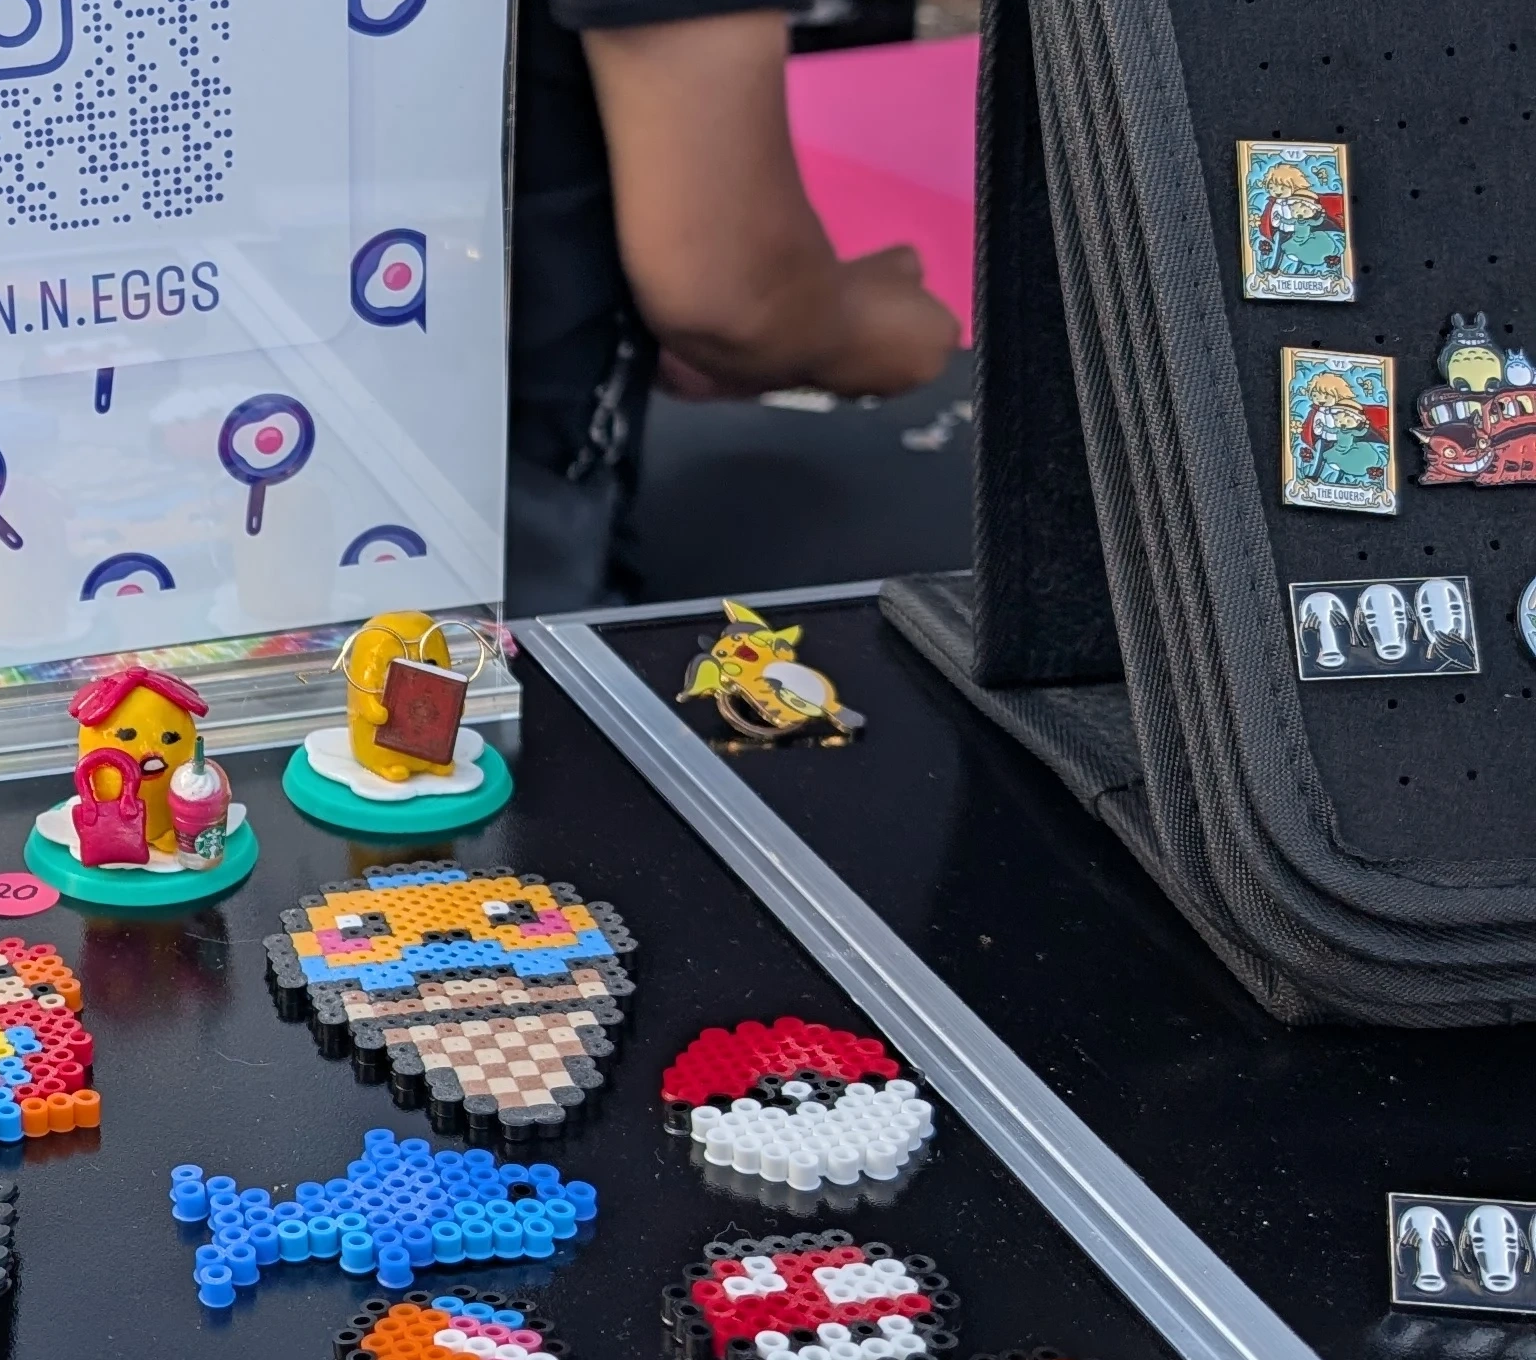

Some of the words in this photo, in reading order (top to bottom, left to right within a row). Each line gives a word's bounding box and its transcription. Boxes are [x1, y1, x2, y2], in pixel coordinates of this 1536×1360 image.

[1276, 280, 1292, 289] THE
[1332, 359, 1345, 367] VI
[1316, 488, 1332, 498] THE
